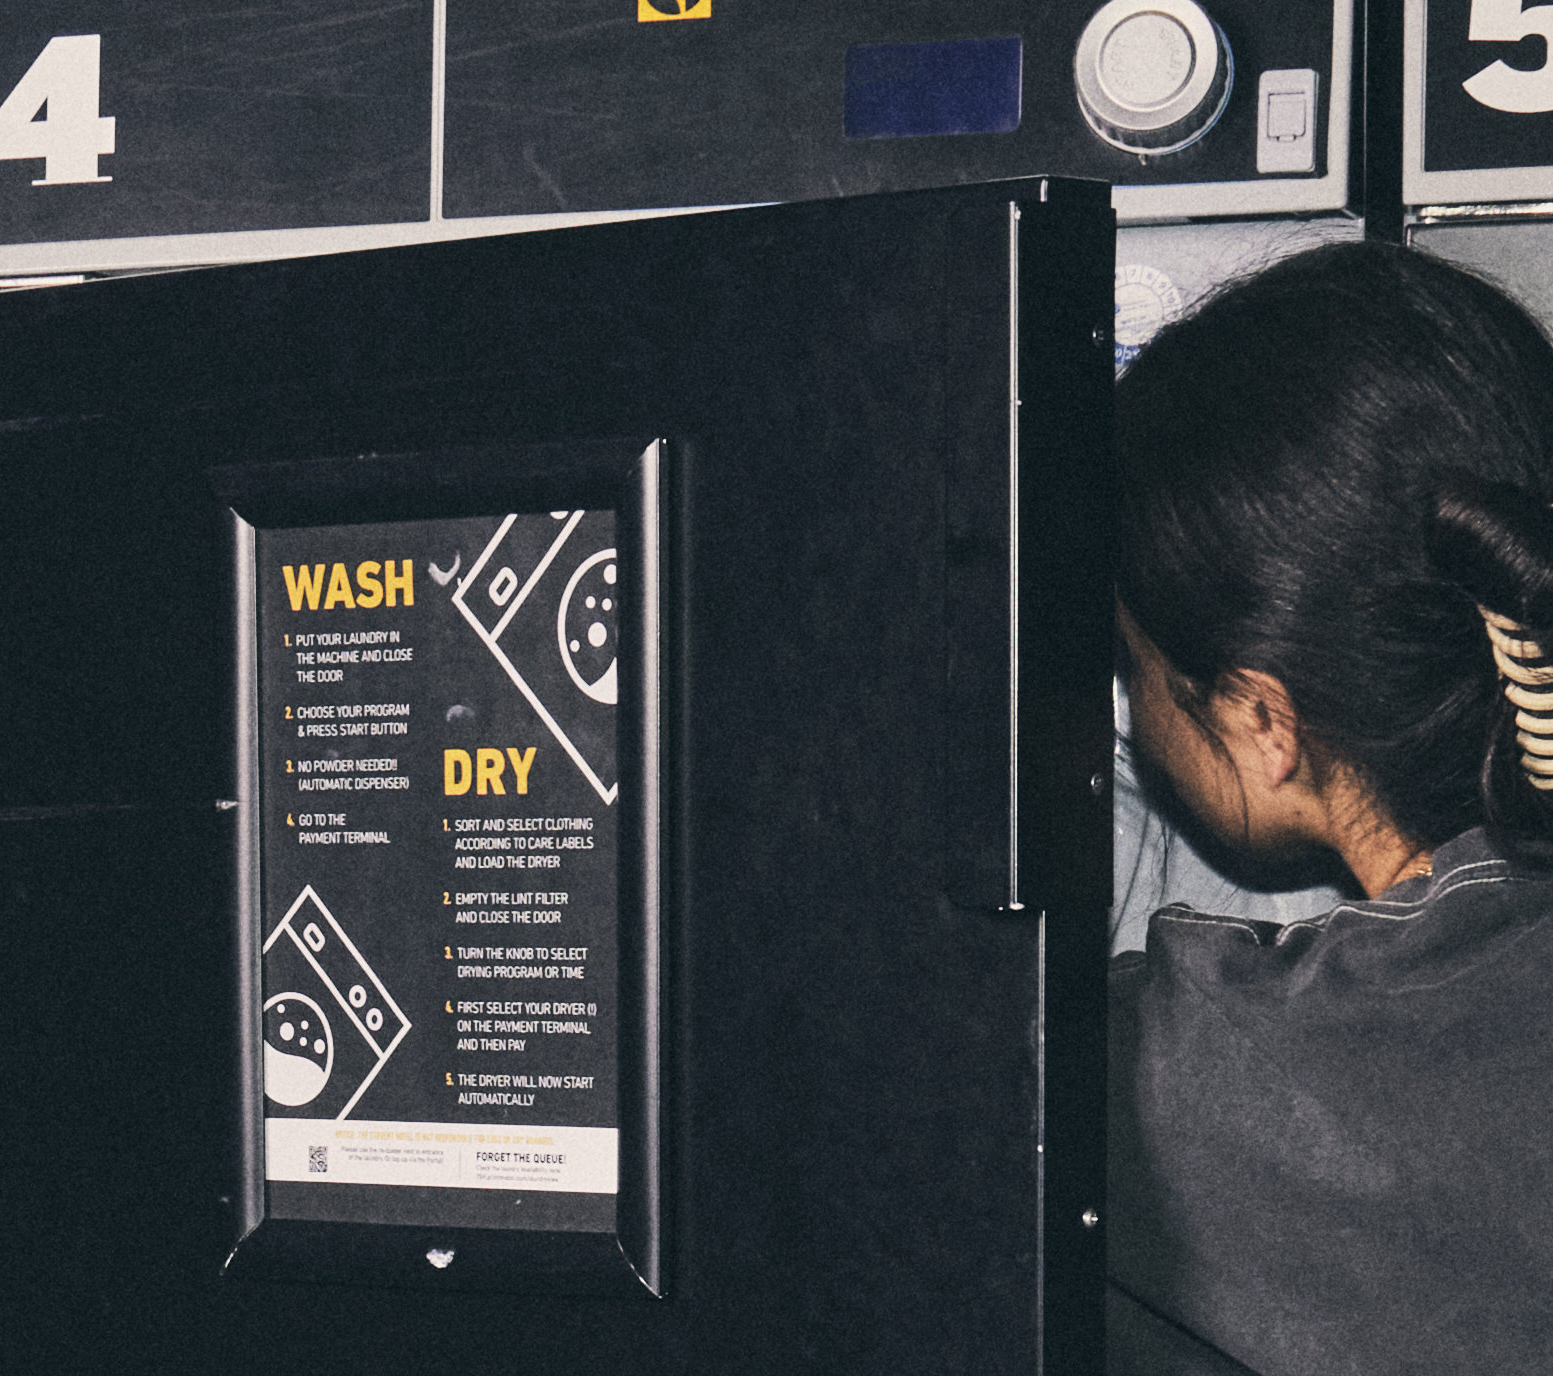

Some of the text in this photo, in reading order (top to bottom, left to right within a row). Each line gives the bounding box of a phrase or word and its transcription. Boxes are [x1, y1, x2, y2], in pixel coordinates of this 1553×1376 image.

[282, 559, 415, 611] WASH
[296, 634, 314, 646] PUT
[317, 633, 341, 645] YOUR
[343, 631, 388, 644] LAUNDRY
[390, 631, 400, 643] IN
[296, 648, 413, 665] THE MACHINE AND CLOSE
[296, 669, 343, 683] THE DOOR
[297, 706, 335, 719] CHOOSE
[336, 705, 362, 717] YOUR
[364, 704, 410, 717] PROGRAM
[298, 722, 408, 737] & PRESS START BUTTON
[298, 760, 312, 773] NO
[314, 760, 354, 772] POWDER
[356, 759, 397, 772] NEEDED!!
[443, 747, 537, 797] DRY
[299, 776, 410, 791] (AUTOMATIC DISPENSER)
[299, 814, 312, 826] GO
[314, 814, 326, 826] TO
[328, 813, 346, 826] THE
[455, 819, 481, 831] SORT
[483, 818, 505, 831] AND
[506, 818, 544, 831] SELECT
[545, 817, 593, 831] CLOTHING
[299, 832, 390, 844] PAYMENT TERMINAL
[455, 836, 594, 850] ACCORDING TO CARE LABELS
[455, 855, 561, 868] AND LOAD THE DRYER
[455, 893, 489, 905] EMPTY
[490, 893, 510, 905] THE
[511, 893, 533, 905] LINT
[535, 893, 568, 905] FILTER
[455, 911, 561, 923] AND CLOSE THE DOOR
[457, 947, 483, 959] TURN
[485, 947, 504, 959] THE
[506, 947, 534, 960] KNOB
[536, 947, 549, 960] TO
[551, 947, 588, 960] SELECT
[458, 966, 584, 979] DRYING PROGRAM OR TIME
[458, 1002, 484, 1013] FIRST
[486, 1002, 523, 1014] SELECT
[525, 1002, 551, 1015] YOUR
[553, 1003, 585, 1015] DRYER
[587, 1003, 597, 1016] (!)
[457, 1020, 591, 1034] ON THE PAYMENT TERMINAL
[457, 1038, 526, 1051] AND THEN PAY
[458, 1074, 477, 1086] THE
[479, 1074, 510, 1087] DRYER
[512, 1075, 537, 1088] WILL
[538, 1076, 562, 1088] NOW
[564, 1076, 594, 1089] START
[458, 1092, 535, 1106] AUTOMATICALLY
[475, 1151, 512, 1163] FORGET
[513, 1152, 532, 1163] THE
